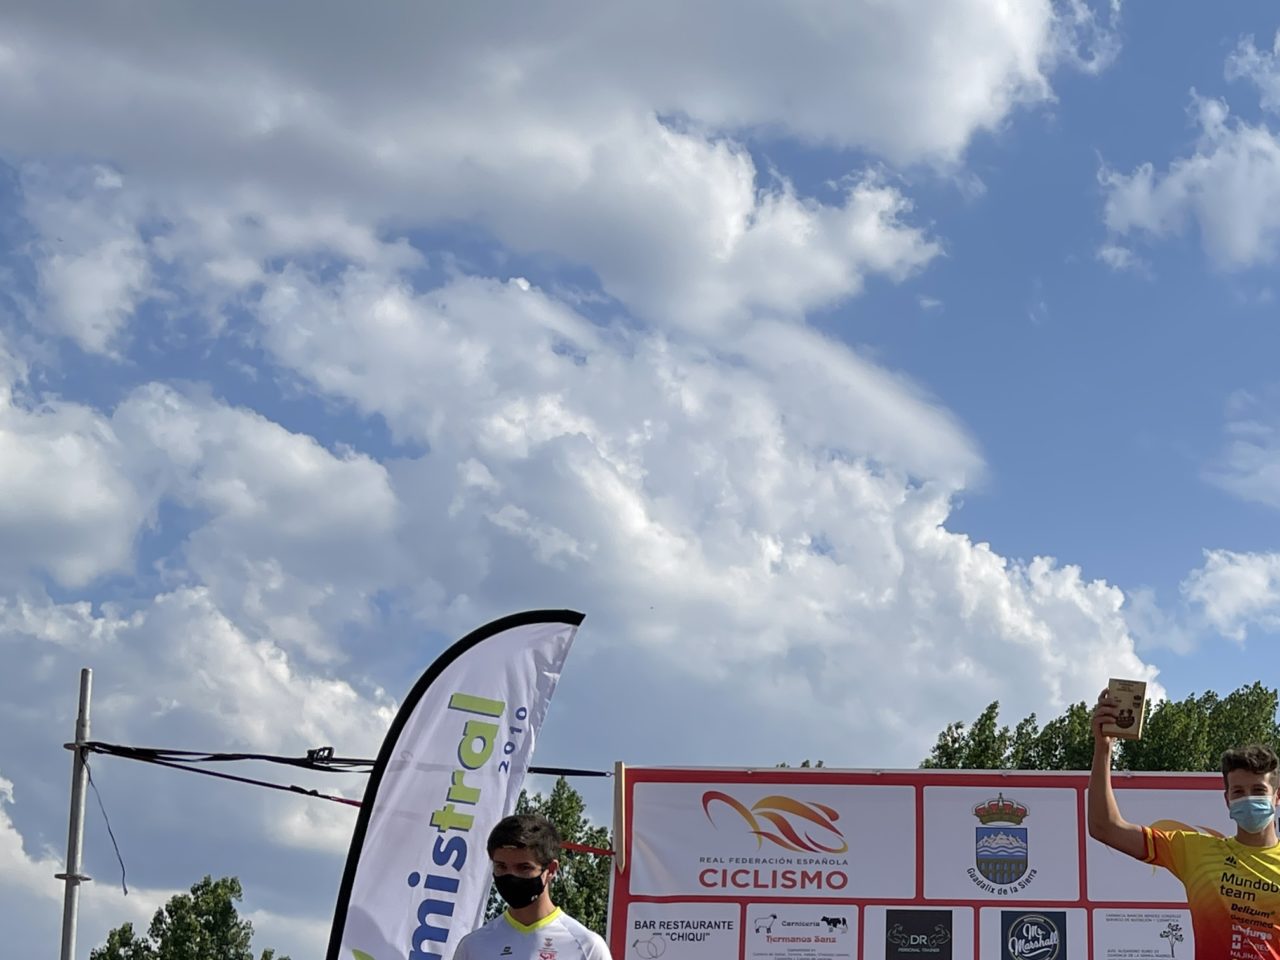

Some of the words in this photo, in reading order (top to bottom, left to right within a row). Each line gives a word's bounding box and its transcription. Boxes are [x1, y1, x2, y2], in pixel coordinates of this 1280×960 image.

[498, 705, 528, 774] 2010
[699, 856, 725, 864] REAL
[729, 856, 793, 865] FEDERACIÓN
[797, 857, 848, 865] ESPAÑOLA
[699, 868, 848, 890] CICLISMO
[966, 867, 996, 894] Guadalix
[997, 887, 1008, 895] de
[1010, 885, 1019, 894] la
[1018, 868, 1038, 889] Sierra
[1220, 885, 1256, 902] team
[634, 921, 656, 930] BAR
[659, 920, 734, 930] RESTAURANTE
[666, 932, 710, 942] "CHIQUI"
[910, 935, 927, 945] DR
[1008, 930, 1059, 956] Marshall
